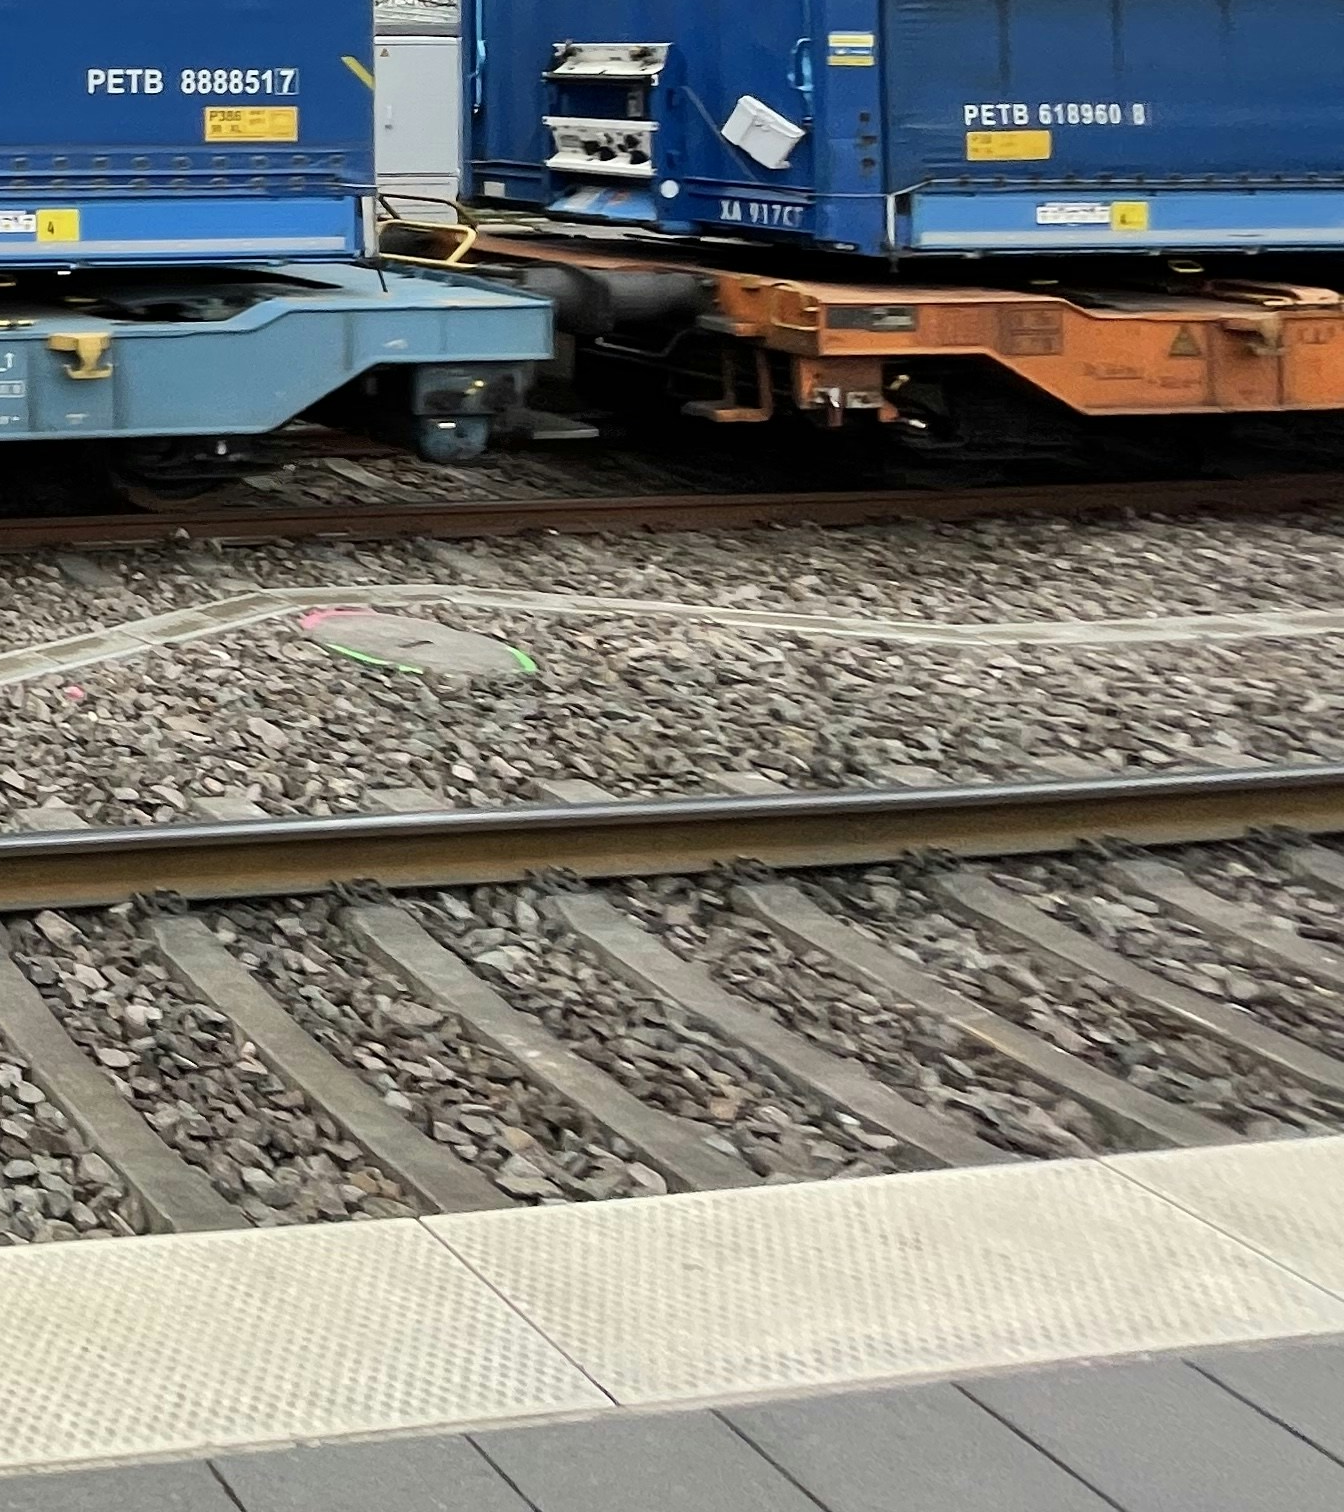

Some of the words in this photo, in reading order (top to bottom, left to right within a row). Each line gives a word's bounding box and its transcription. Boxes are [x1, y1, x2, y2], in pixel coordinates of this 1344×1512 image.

[87, 69, 163, 94] PETB
[181, 69, 296, 95] 8888517
[964, 103, 1029, 126] PETB
[1038, 103, 1122, 125] 618960
[1132, 103, 1146, 125] 8
[720, 200, 742, 221] XA
